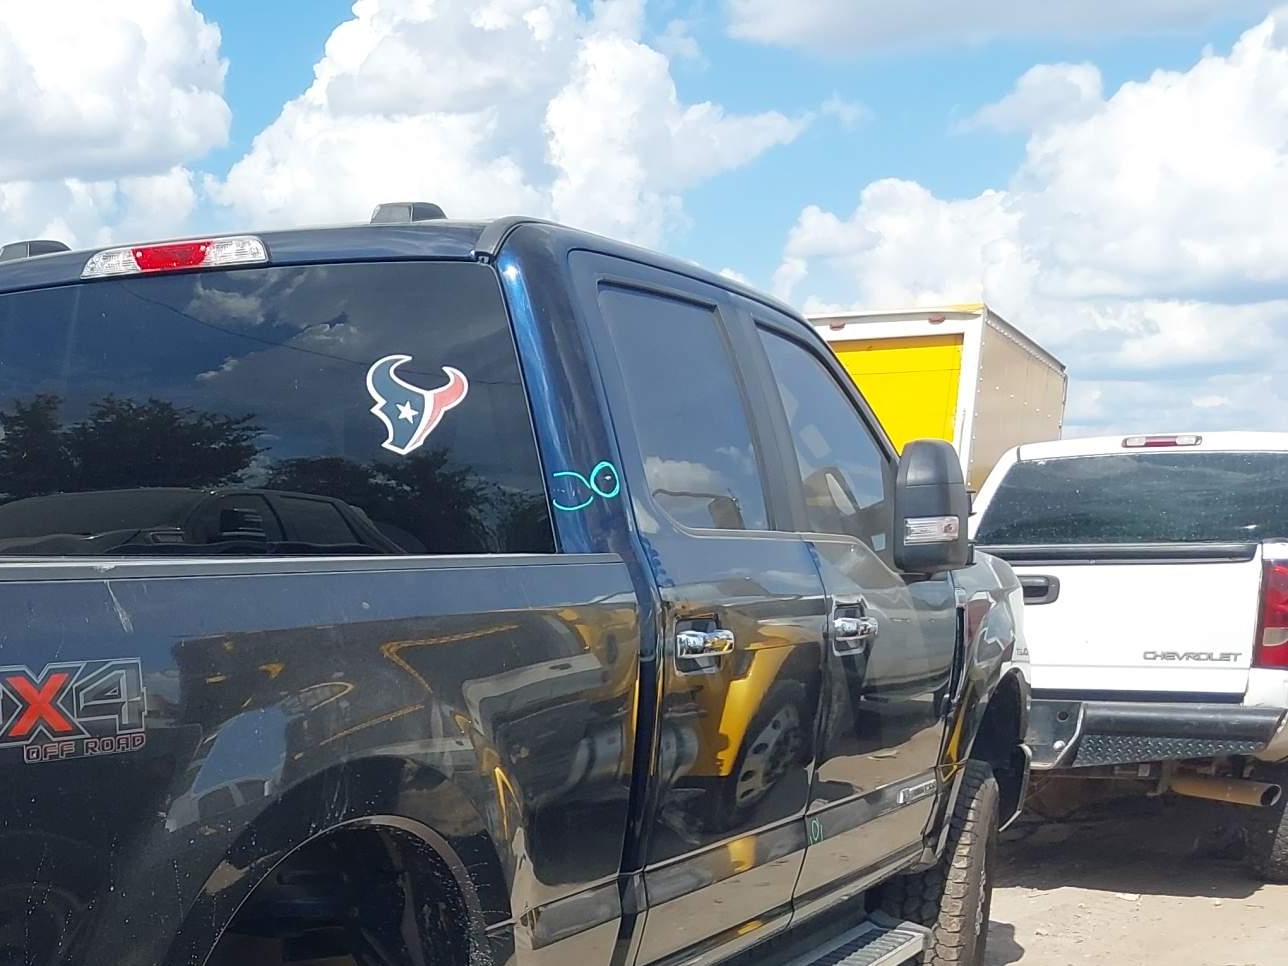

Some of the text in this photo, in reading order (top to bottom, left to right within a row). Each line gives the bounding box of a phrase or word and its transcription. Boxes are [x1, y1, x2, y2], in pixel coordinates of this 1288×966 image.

[1143, 650, 1242, 662] CHEVROLET
[24, 733, 146, 763] OFF ROAD
